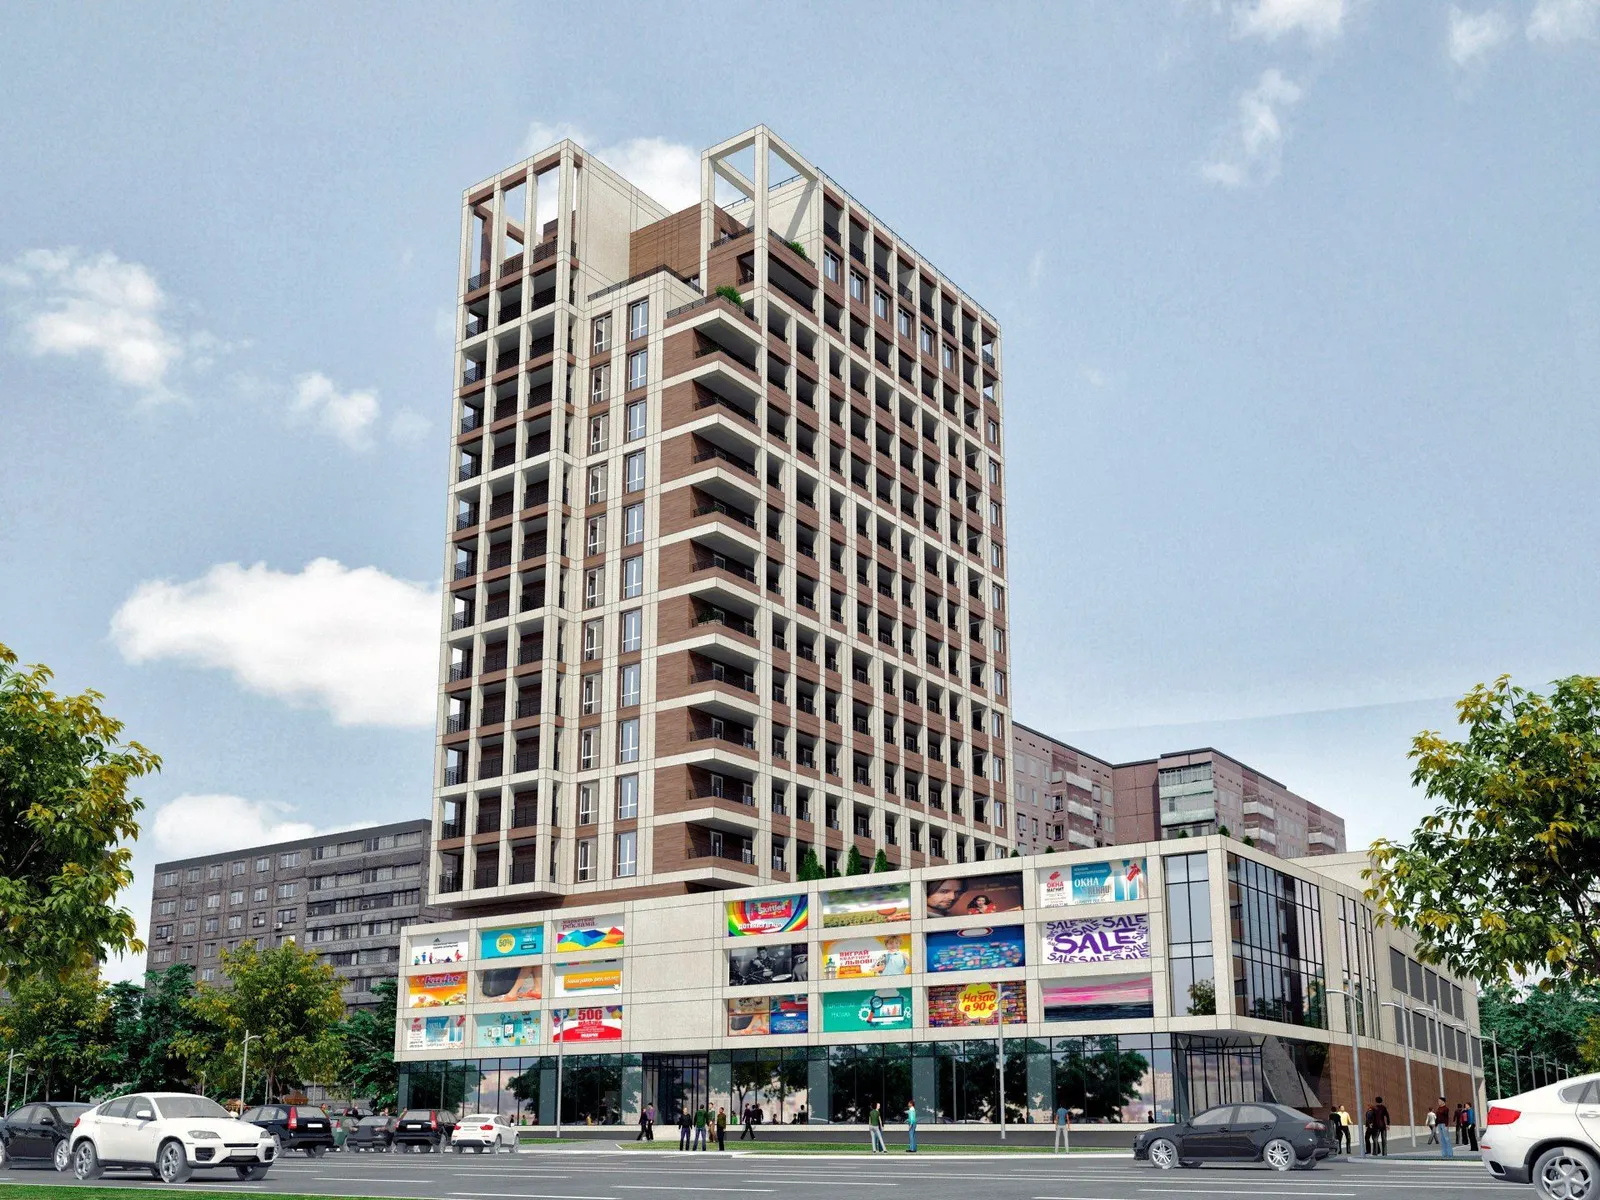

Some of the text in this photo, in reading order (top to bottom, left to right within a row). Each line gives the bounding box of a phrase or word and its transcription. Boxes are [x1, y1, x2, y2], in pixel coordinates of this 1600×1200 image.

[1046, 881, 1064, 889] ОКНА
[1074, 877, 1099, 888] ОКНА
[1046, 920, 1077, 930] SALE
[1102, 914, 1147, 928] SALE
[1071, 920, 1102, 936] SALE
[498, 938, 513, 947] 50%
[1053, 928, 1137, 954] SALE
[839, 949, 869, 957] ВИГРАЙ
[1124, 942, 1150, 953] SALE
[1047, 952, 1078, 964] SALE
[963, 990, 996, 1003] Назад
